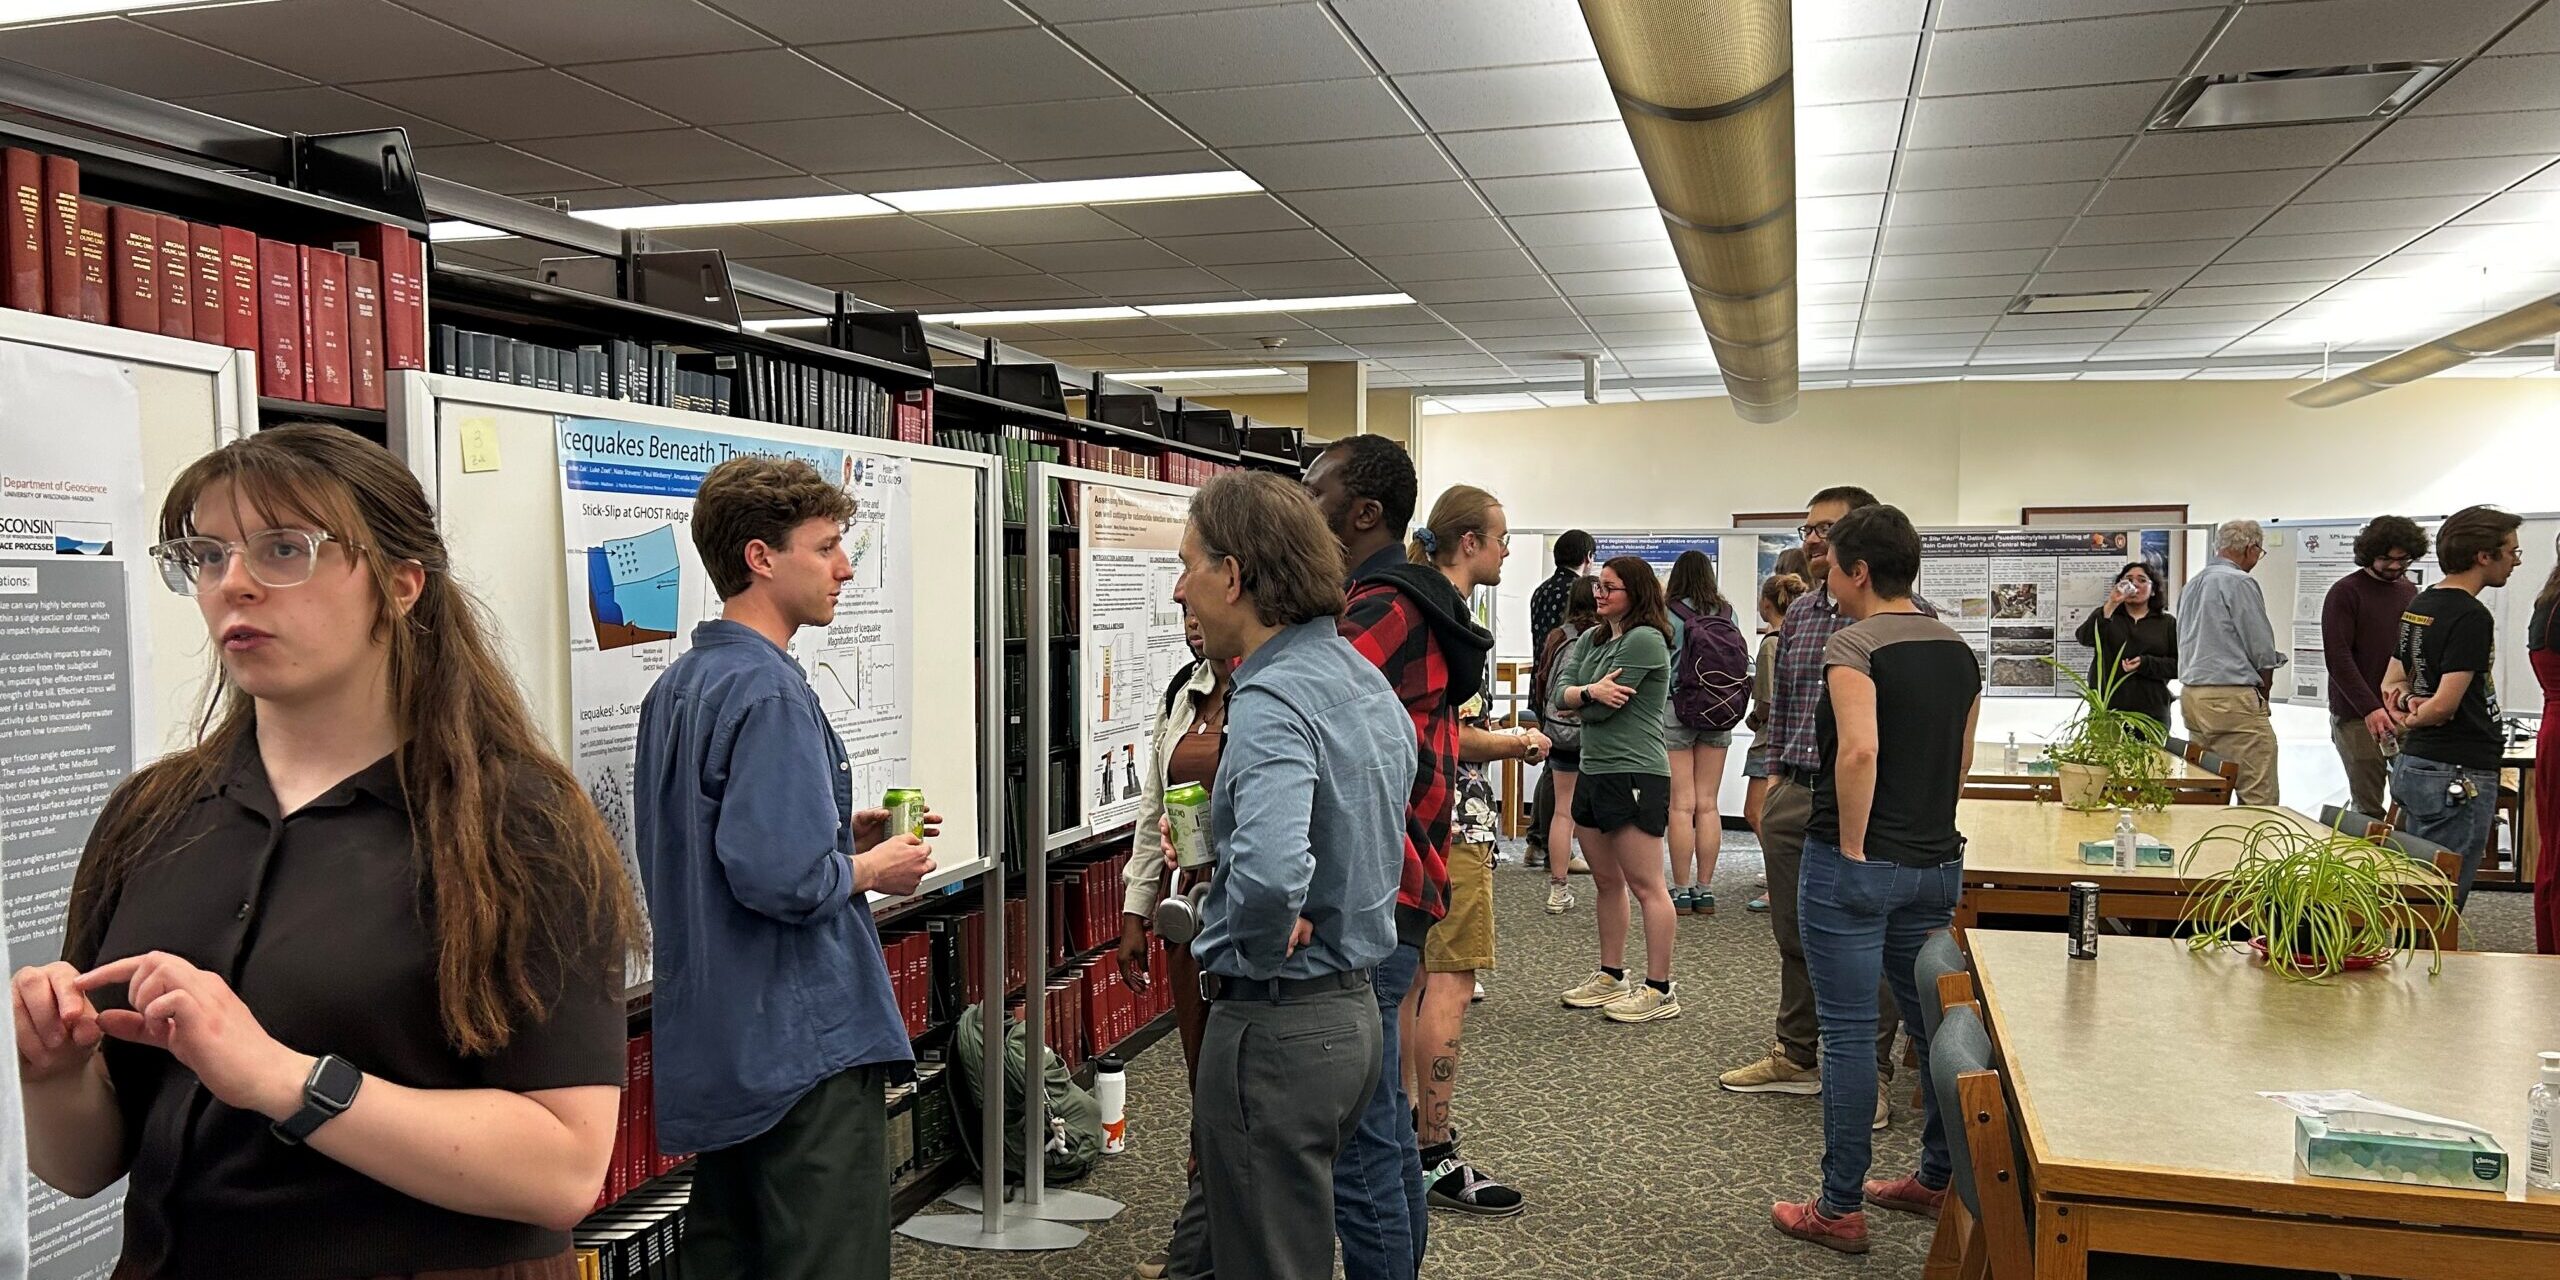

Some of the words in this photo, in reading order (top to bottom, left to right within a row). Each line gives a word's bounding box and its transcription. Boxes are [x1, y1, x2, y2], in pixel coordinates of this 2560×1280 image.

[560, 424, 645, 458] Icequakes
[649, 435, 715, 463] Beneath
[4, 477, 53, 490] Department
[64, 482, 107, 494] Geoscience
[582, 504, 621, 519] Stick-Slip
[633, 507, 663, 519] GHOST
[665, 508, 689, 524] Ridge
[0, 518, 53, 534] SCONSIN
[15, 543, 54, 551] PROCESSES
[2082, 893, 2097, 954] Arizona
